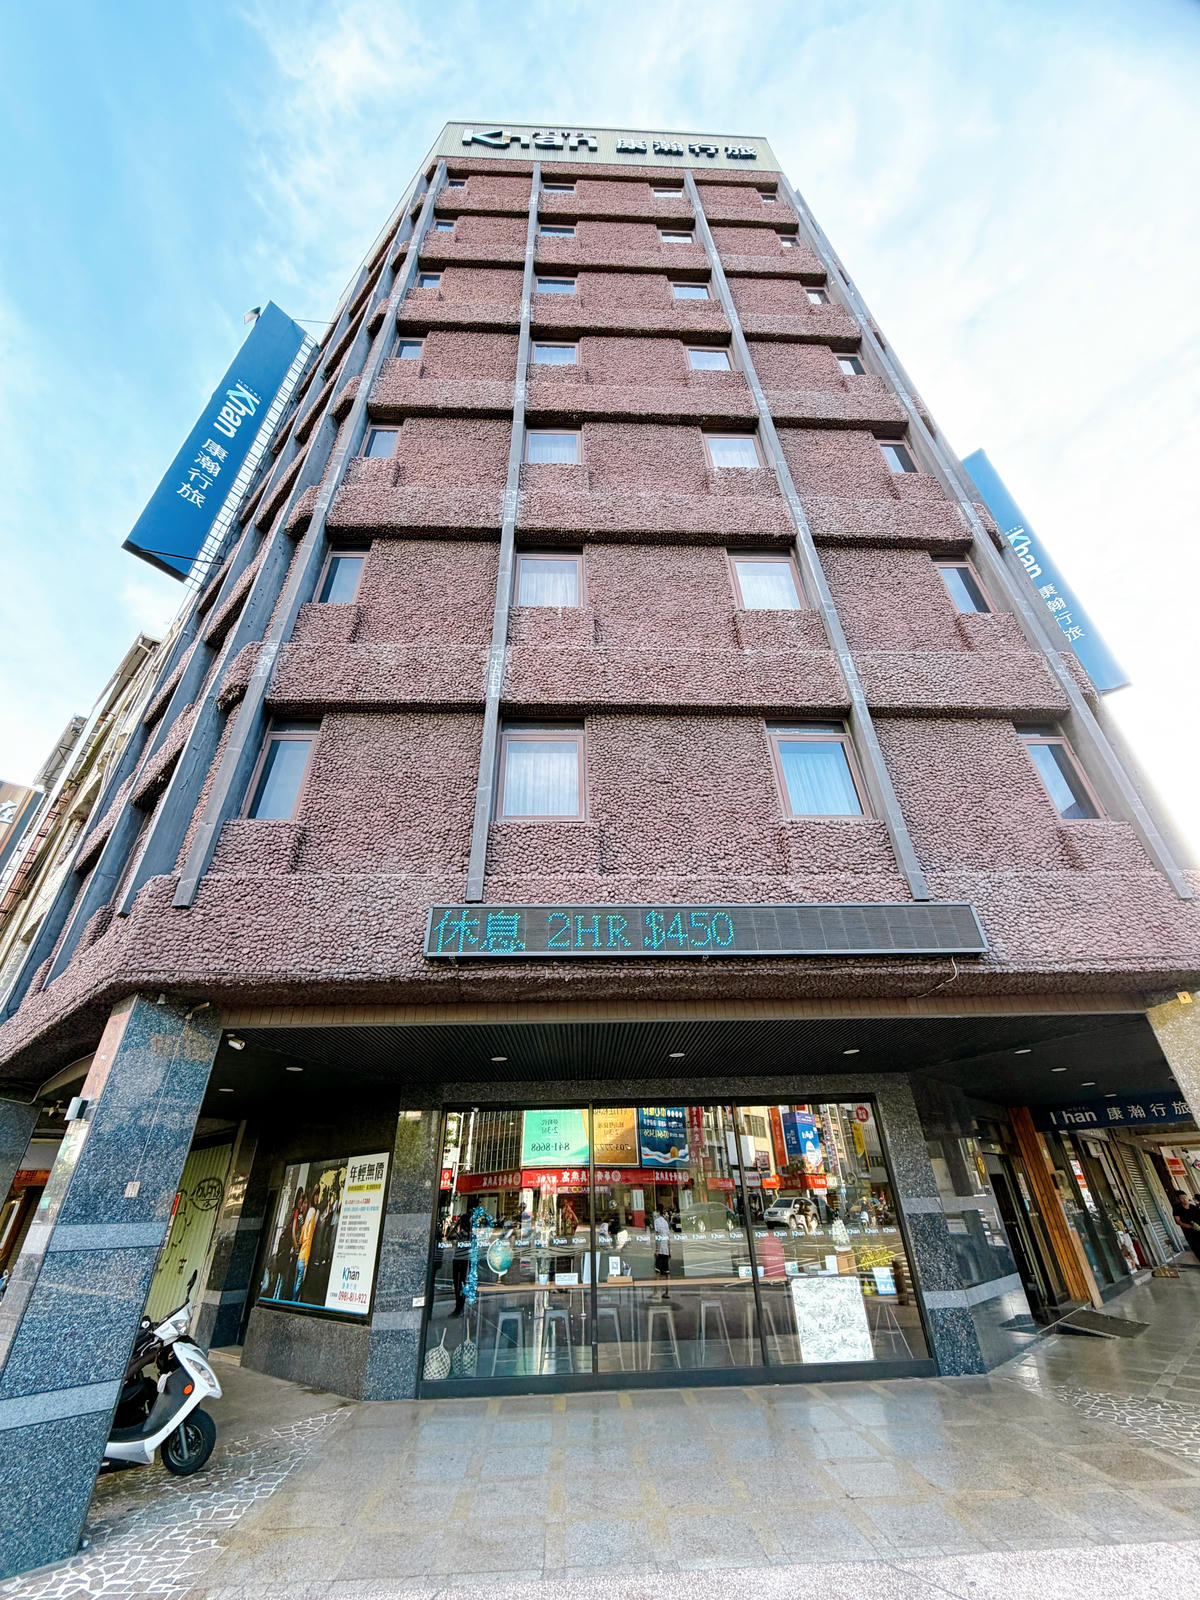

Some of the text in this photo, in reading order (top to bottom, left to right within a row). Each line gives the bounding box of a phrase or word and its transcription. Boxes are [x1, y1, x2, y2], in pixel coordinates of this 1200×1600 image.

[462, 129, 598, 151] Khan
[616, 137, 758, 160] 康瀚行旅
[213, 383, 261, 438] Khan
[177, 438, 229, 509] 康瀚行旅
[1007, 527, 1042, 579] Khan
[433, 910, 734, 953] 休息 2HR $450
[1106, 1100, 1192, 1120] 康瀚行旅
[342, 1266, 360, 1281] Khan
